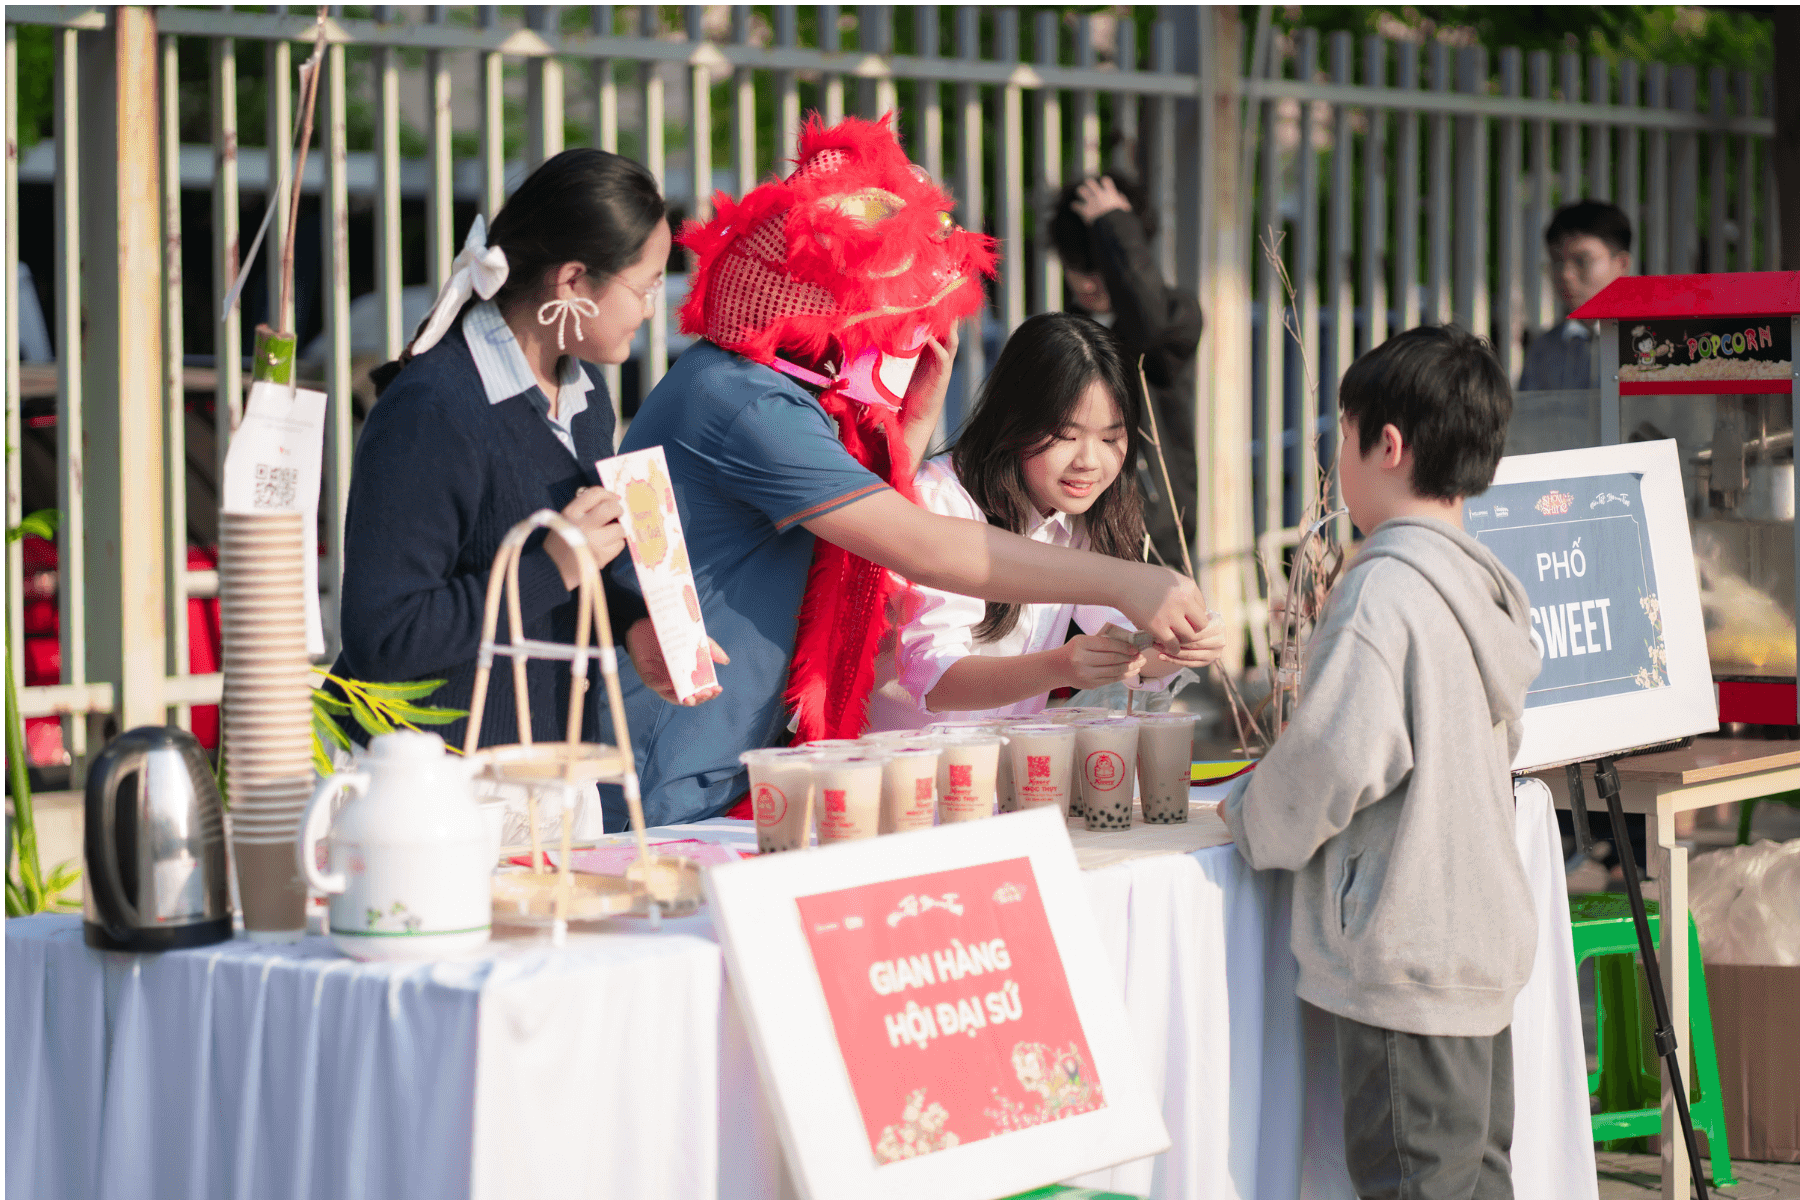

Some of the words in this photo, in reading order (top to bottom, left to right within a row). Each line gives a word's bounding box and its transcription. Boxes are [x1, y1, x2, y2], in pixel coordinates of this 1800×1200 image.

[1686, 325, 1773, 361] POPCORN
[1536, 537, 1587, 582] PHỐ
[1530, 598, 1613, 660] SWEET
[868, 952, 936, 997] GIAN
[933, 937, 1012, 983] HÀNG
[883, 999, 938, 1051] HỘI
[935, 995, 987, 1038] ĐẠI
[985, 978, 1024, 1025] SỨ
